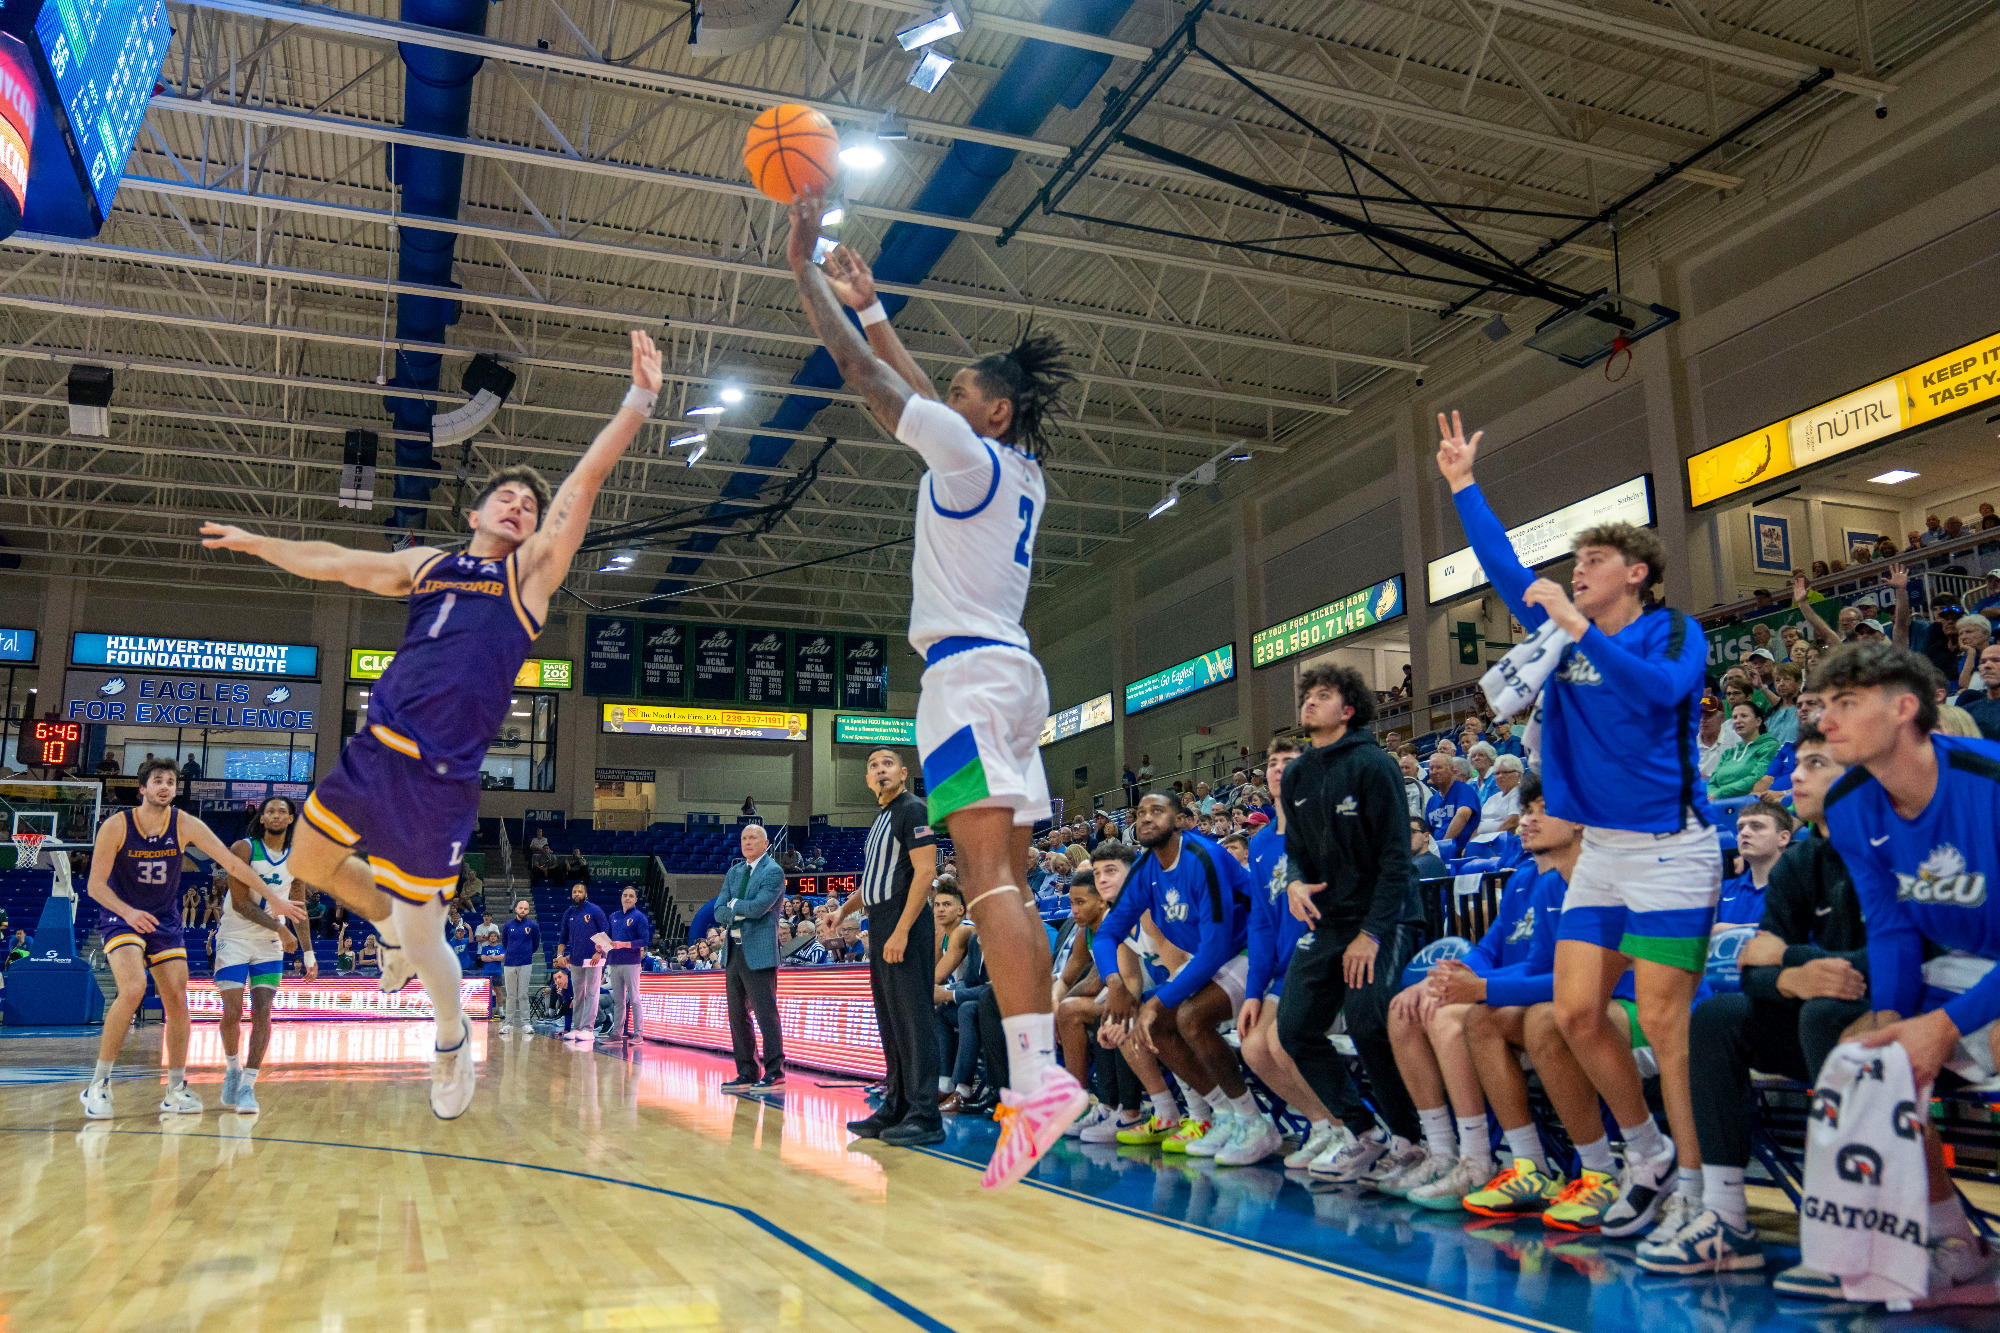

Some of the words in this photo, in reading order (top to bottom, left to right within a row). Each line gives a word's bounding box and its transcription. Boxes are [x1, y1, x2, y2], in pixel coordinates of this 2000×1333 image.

[1922, 356, 1978, 389] KEEP
[1013, 494, 1034, 568] 2
[414, 580, 503, 596] LIPSCOMB
[429, 593, 456, 638] 1
[1253, 632, 1267, 645] GET
[1268, 624, 1288, 640] YOUR
[1289, 616, 1309, 633] FGCU
[1311, 602, 1345, 623] TICKETS
[1346, 591, 1369, 608] NOW!
[647, 635, 681, 646] FGCU
[1256, 607, 1366, 665] 239.590.7145
[106, 636, 289, 659] HILLMYER-TREMONT
[699, 639, 733, 649] FGCU
[748, 642, 782, 653] FGCU
[798, 645, 831, 656] FGCU
[590, 651, 631, 661] TOURNAMENT
[653, 654, 674, 664] NCAA
[847, 648, 879, 659] FGCU
[106, 650, 227, 670] FOUNDATION
[231, 656, 287, 673] SUITE
[643, 661, 684, 671] TOURNAMENT
[705, 657, 725, 666] NCAA
[755, 660, 775, 670] NCAA
[805, 664, 824, 673] NCAA
[543, 670, 569, 679] ZOO
[696, 664, 735, 674] TOURNAMENT
[746, 668, 785, 677] TOURNAMENT
[796, 671, 834, 680] TOURNAMENT
[854, 667, 873, 676] NCAA
[1161, 674, 1170, 688] Go
[1171, 662, 1195, 685] Eagles!
[845, 673, 884, 683] TOURNAMENT
[139, 679, 250, 704] EAGLES
[69, 700, 127, 722] FOR
[136, 703, 313, 729] EXCELLENCE
[639, 711, 651, 719] The
[652, 711, 672, 720] North
[726, 714, 782, 725] 239-337-1191
[36, 723, 78, 741] 6:46
[650, 723, 693, 734] Accident
[695, 725, 702, 734] &
[705, 725, 731, 736] Injury
[733, 727, 763, 738] Cases
[43, 741, 65, 763] 10
[128, 848, 178, 858] LIPSCOMB
[449, 842, 463, 867] L
[138, 861, 167, 885] 33
[596, 867, 628, 876] COFFEE
[629, 867, 643, 877] CO.
[799, 877, 815, 893] 56
[827, 875, 855, 892] 6:46
[274, 990, 299, 1010] ON
[309, 990, 343, 1010] THE
[804, 996, 842, 1046] MUSIC
[846, 997, 883, 1051] VENU
